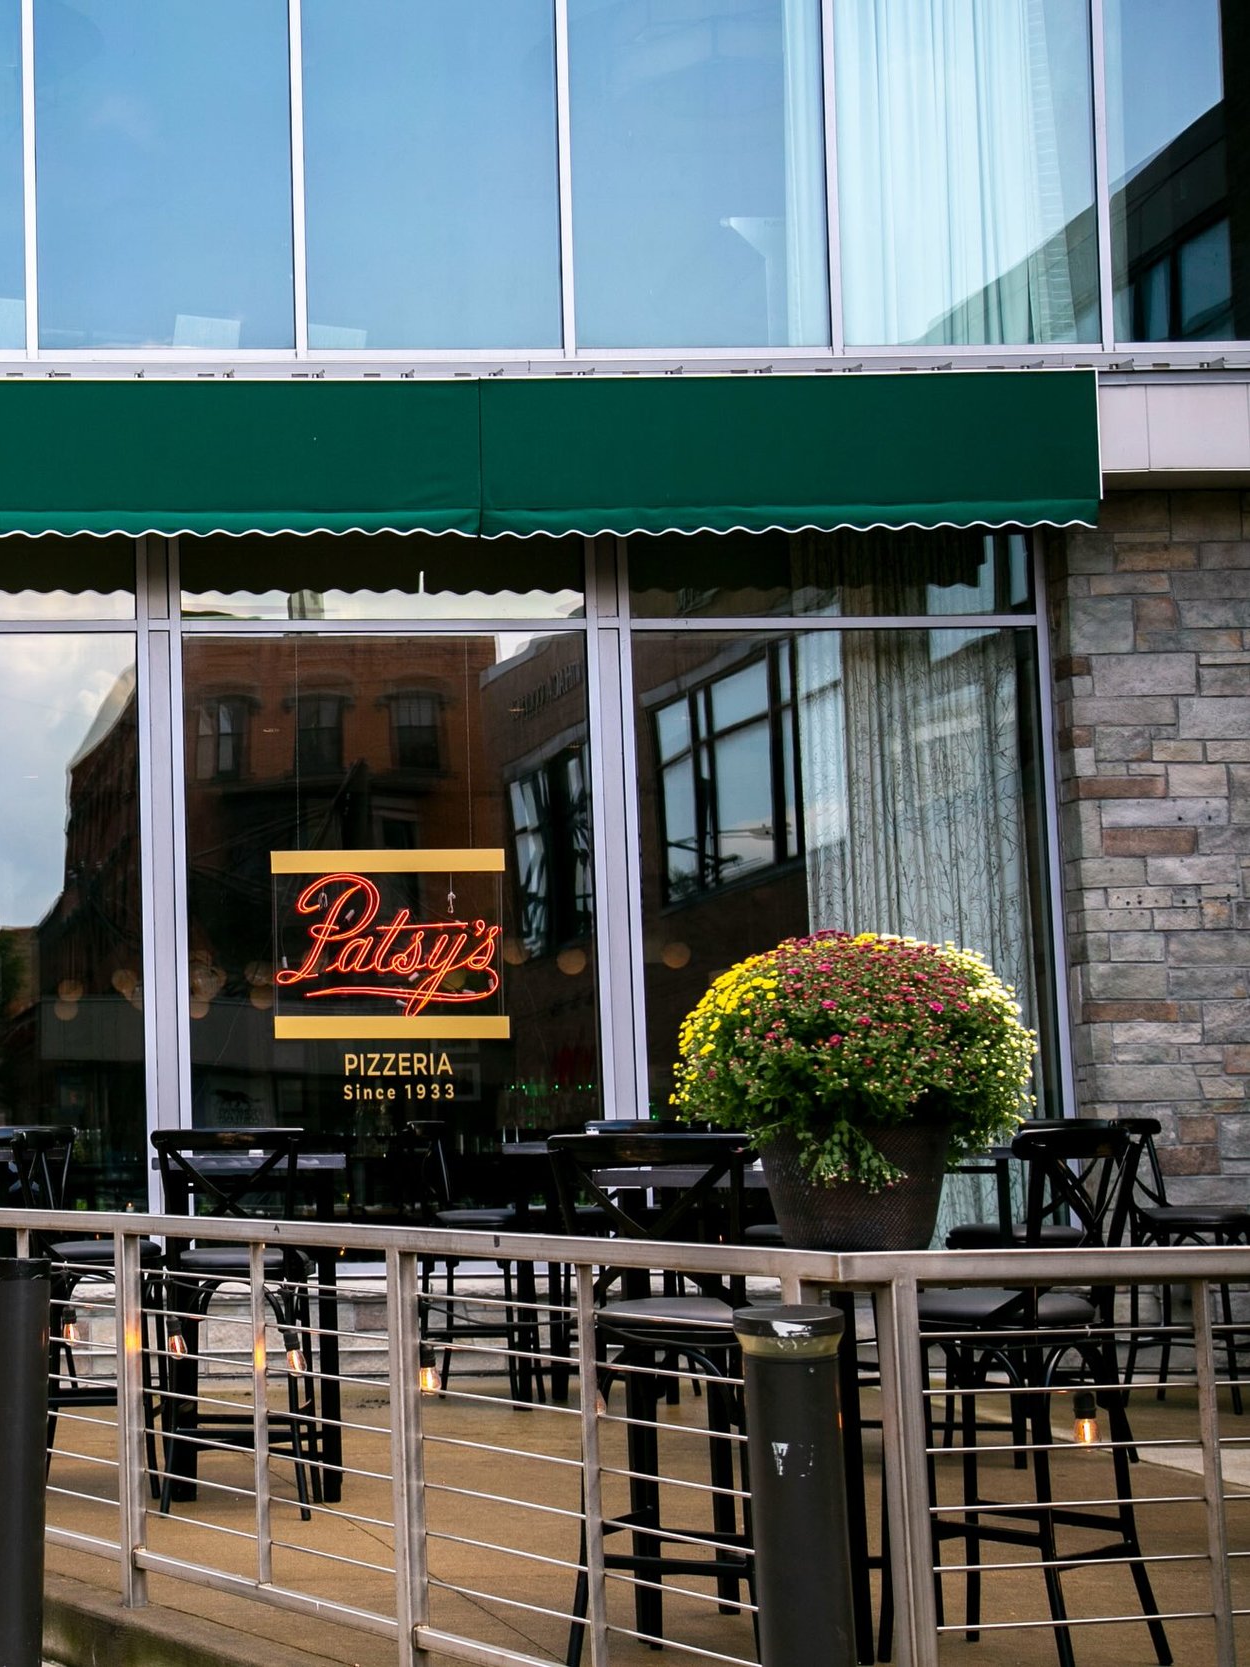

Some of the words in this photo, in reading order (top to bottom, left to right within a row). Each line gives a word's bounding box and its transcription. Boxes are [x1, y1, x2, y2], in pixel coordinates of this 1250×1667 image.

[276, 873, 502, 1016] Patsy's
[344, 1053, 453, 1076] PIZZERIA
[343, 1084, 396, 1100] Since
[404, 1084, 455, 1100] 1933
